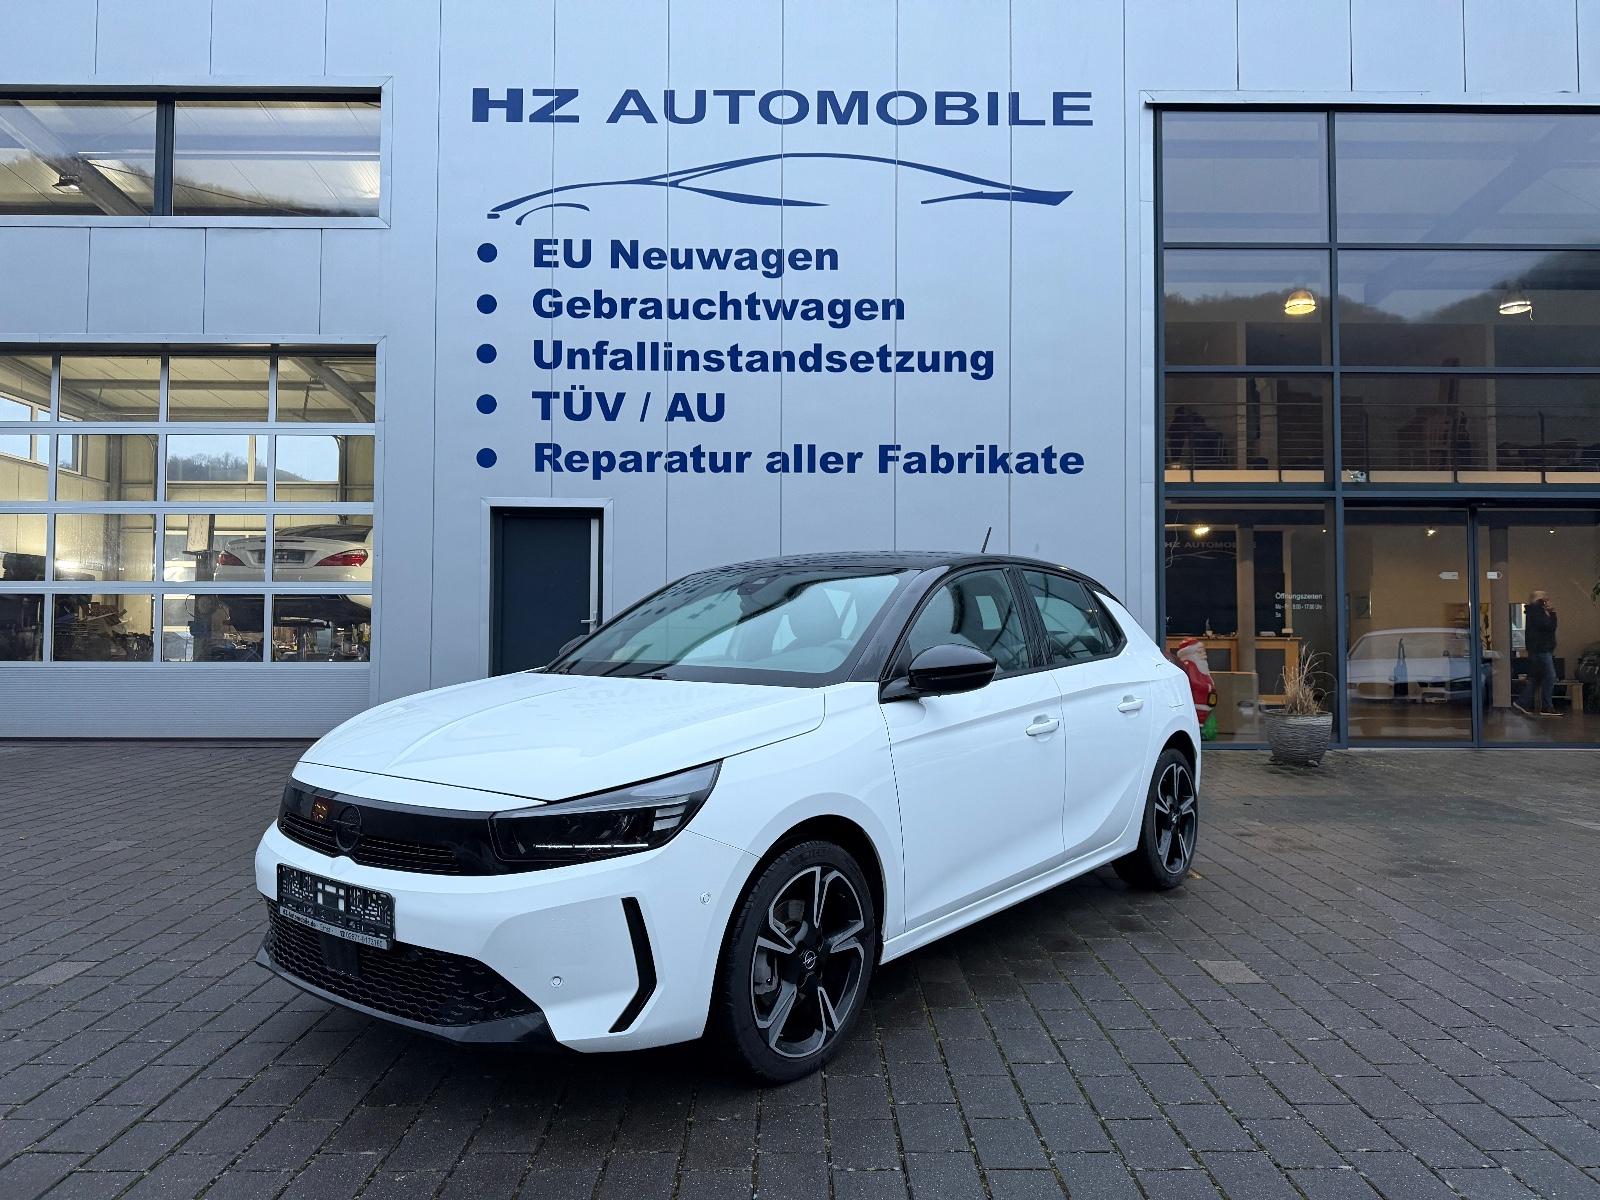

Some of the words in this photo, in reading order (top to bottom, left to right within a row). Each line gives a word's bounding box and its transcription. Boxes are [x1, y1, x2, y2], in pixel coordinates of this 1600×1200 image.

[472, 88, 580, 123] HZ
[607, 89, 1094, 126] AUTOMOBILE
[533, 239, 592, 269] EU
[611, 240, 839, 278] Neuwagen
[533, 289, 905, 328] Gebrauchtwagen
[533, 340, 994, 380] Unfallinstandsetzung
[532, 385, 626, 421] TÜV
[640, 392, 651, 422] /
[665, 393, 726, 423] AU
[535, 443, 752, 480] Reparatur
[766, 444, 864, 473] aller
[879, 445, 1085, 474] Fabrikate
